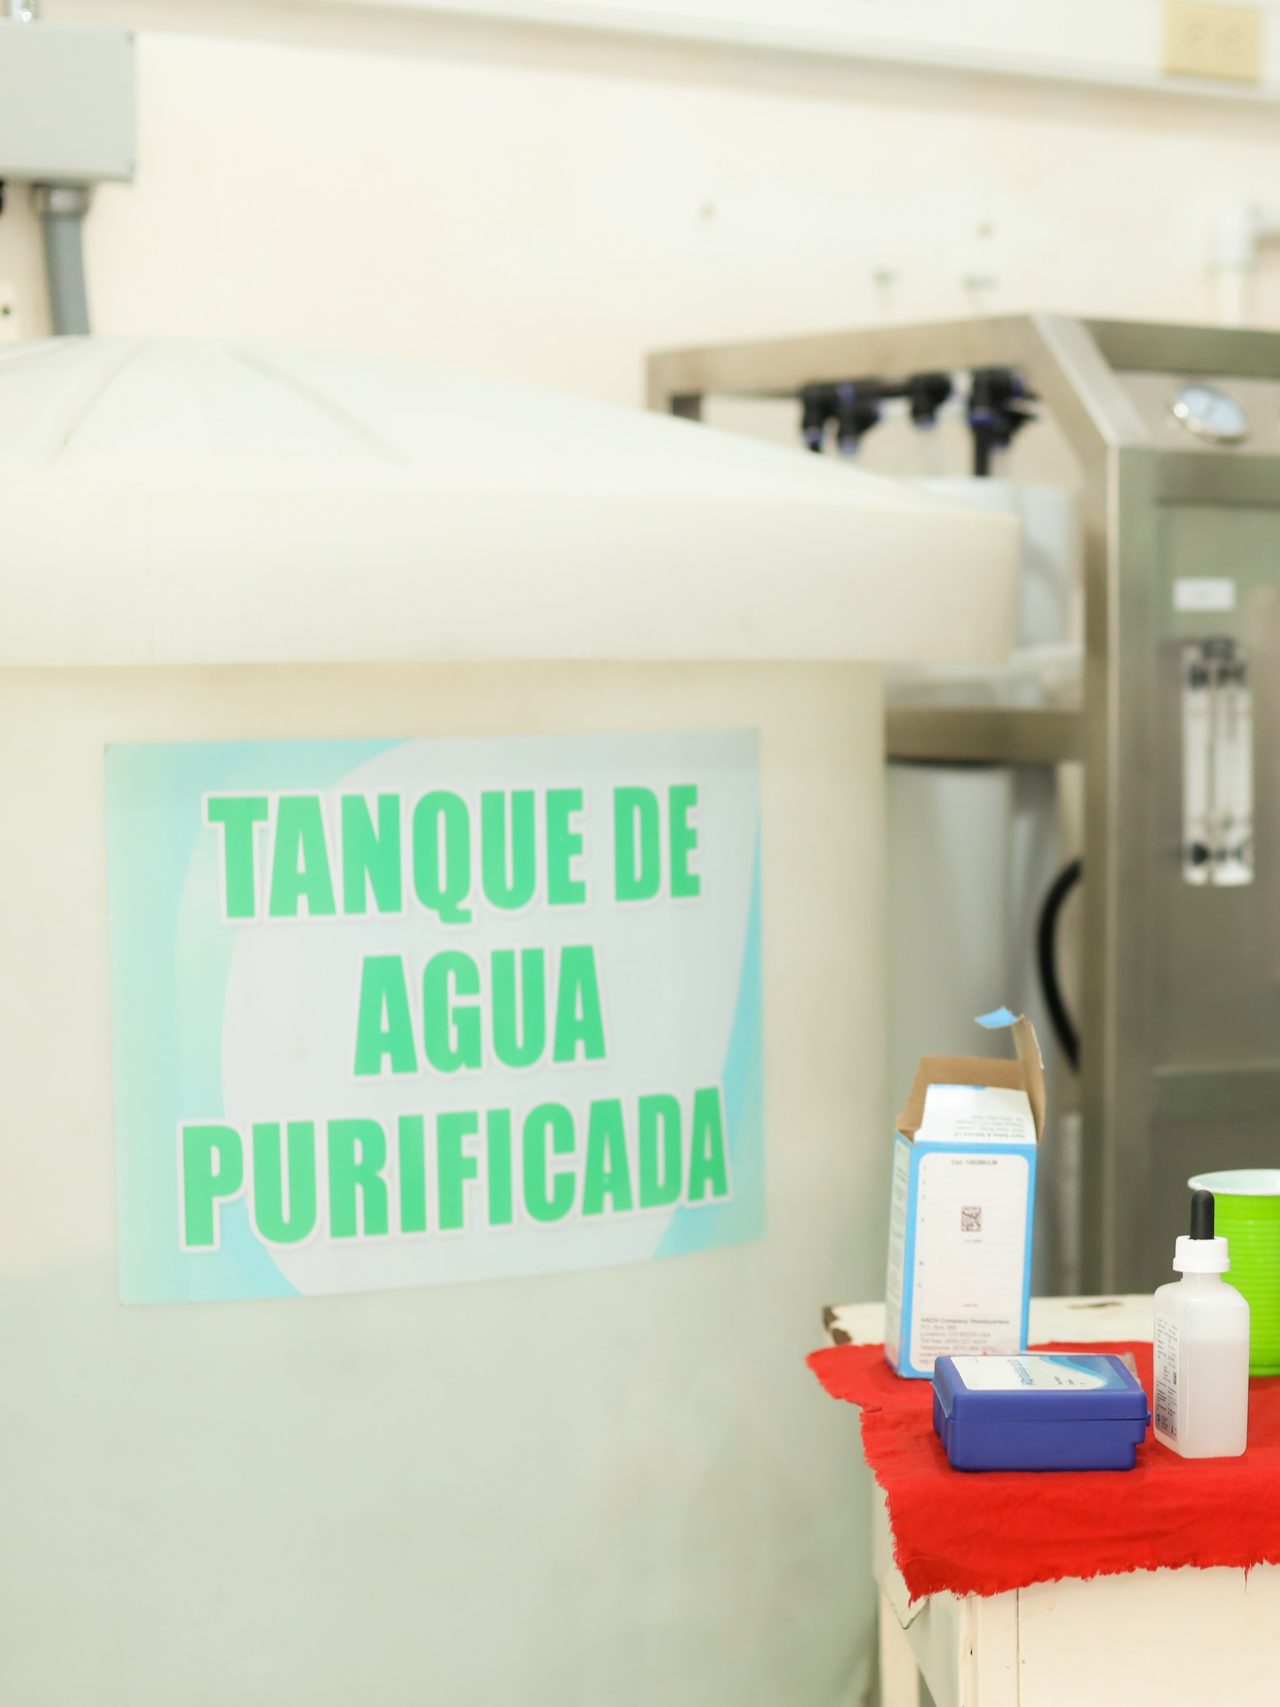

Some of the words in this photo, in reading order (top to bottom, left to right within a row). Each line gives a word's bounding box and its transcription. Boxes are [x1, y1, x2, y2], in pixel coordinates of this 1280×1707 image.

[207, 787, 587, 925] TANQUE
[613, 784, 701, 901] DE
[353, 944, 606, 1077] AGUA
[182, 1086, 729, 1247] PURIFICADA
